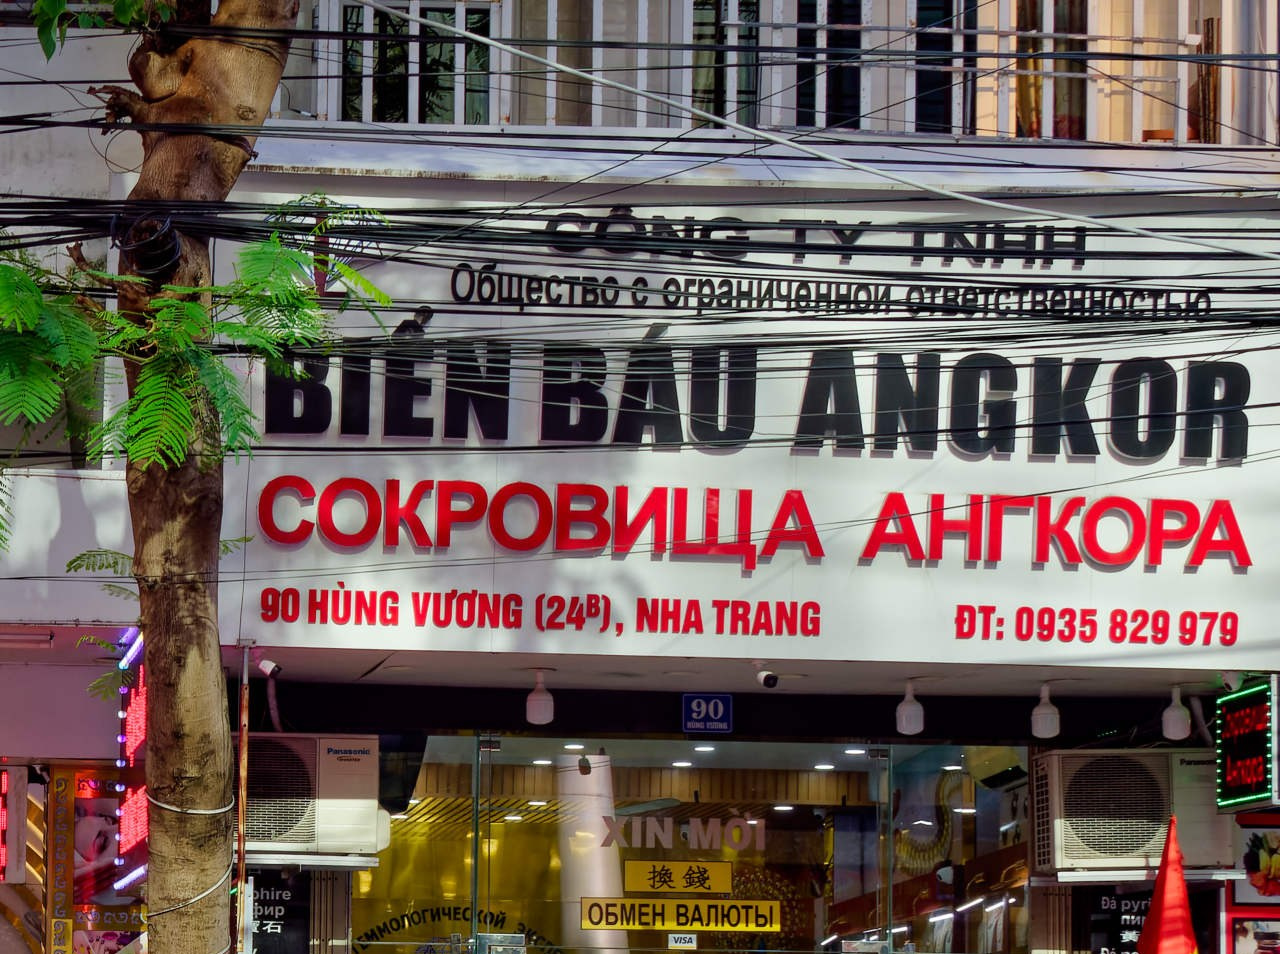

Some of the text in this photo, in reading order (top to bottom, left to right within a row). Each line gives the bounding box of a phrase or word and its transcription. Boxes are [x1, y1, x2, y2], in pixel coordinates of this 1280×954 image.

[778, 219, 871, 265] TY
[898, 220, 1087, 268] TNHH
[450, 259, 620, 310] Общество
[662, 275, 891, 316] ограниченной
[906, 284, 1212, 318] ответственностью
[540, 321, 757, 450] BÁU
[792, 350, 1252, 462] ANGKOR
[258, 474, 1253, 571] СОКРОВИЩА АНГКОРА
[260, 587, 300, 625] 90
[307, 581, 400, 627] HÙNG
[411, 587, 524, 630] VƯƠNG
[635, 597, 704, 635] NHA
[711, 599, 821, 637] TRANG
[954, 603, 1240, 647] ĐT: 0935 829 979
[691, 698, 724, 720] 90
[327, 747, 370, 755] Panasonic
[599, 815, 674, 849] XIN
[587, 901, 775, 929] ОБМЕН ВАЛЮТЫ
[1101, 896, 1117, 910] Đá
[673, 936, 694, 946] VISA
